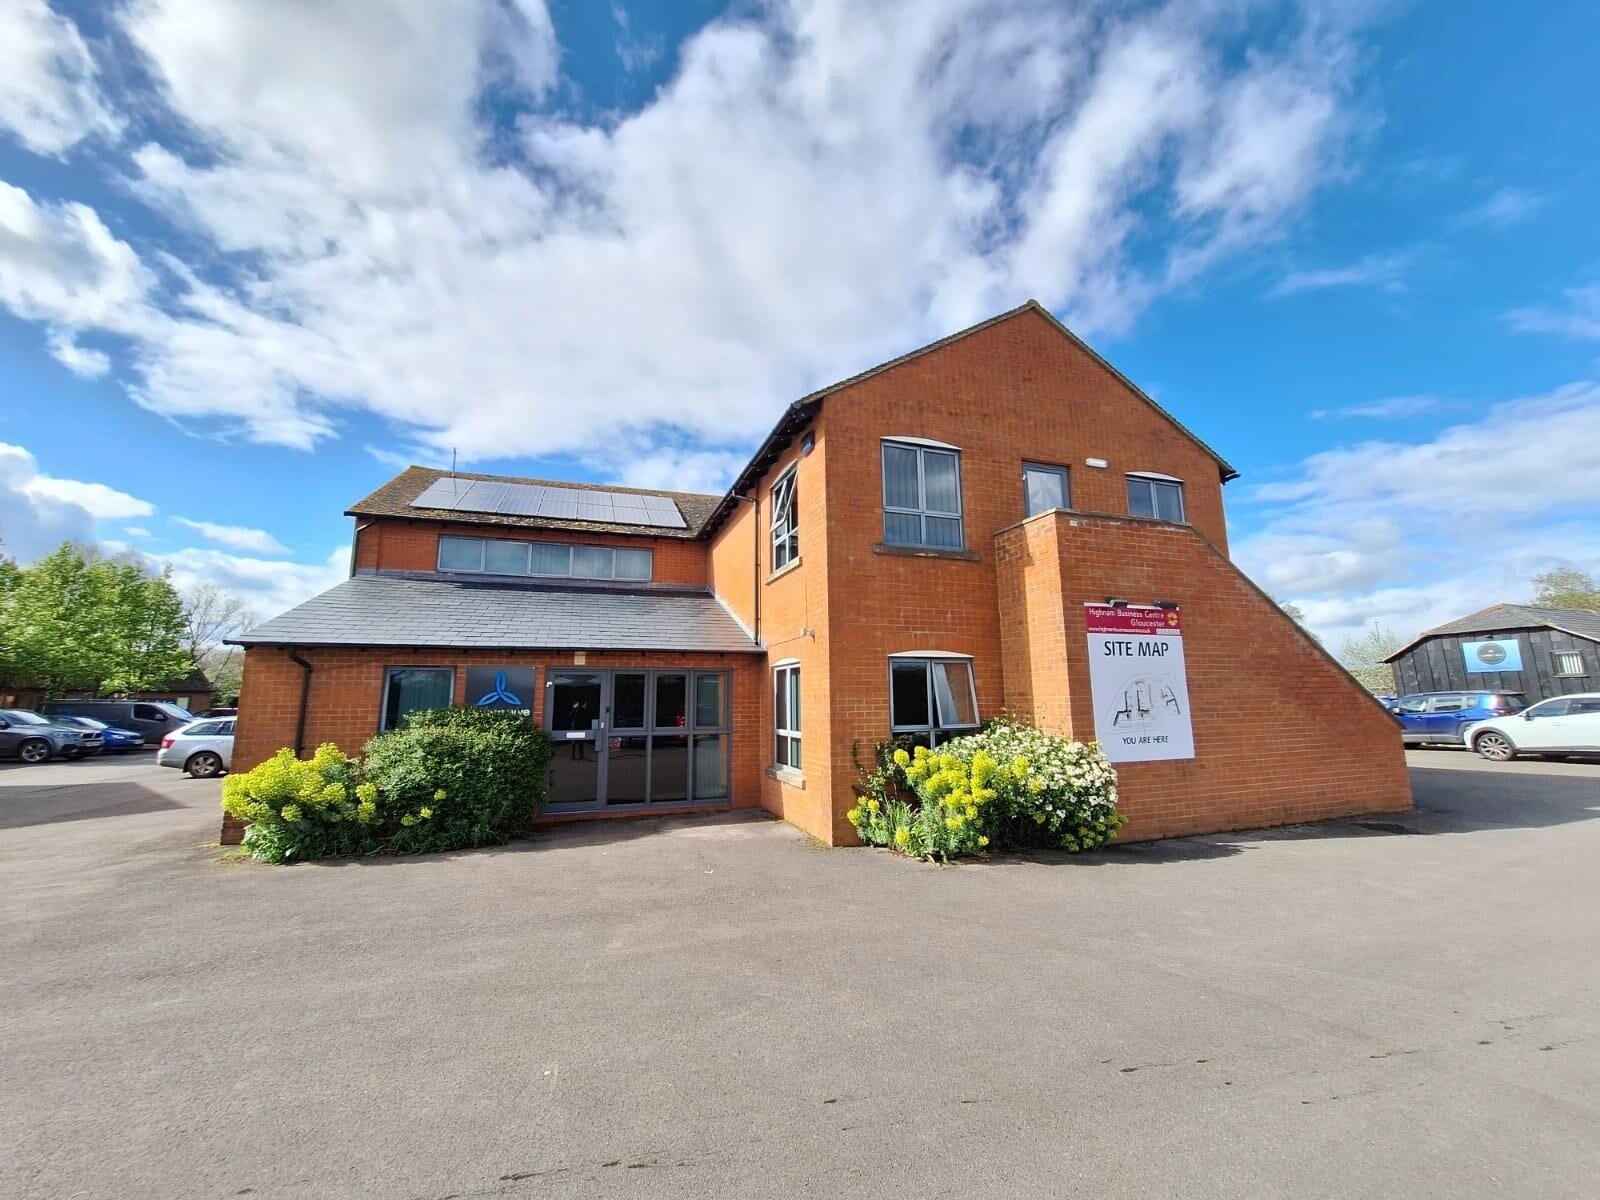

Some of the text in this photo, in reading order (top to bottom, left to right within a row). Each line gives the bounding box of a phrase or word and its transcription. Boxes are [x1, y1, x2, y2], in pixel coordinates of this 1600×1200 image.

[1089, 608, 1164, 618] Highnam Business Centre
[1131, 619, 1165, 627] Gloucester
[1104, 641, 1169, 656] SITE MAP
[1122, 736, 1136, 744] YOU
[1138, 736, 1151, 744] ARE
